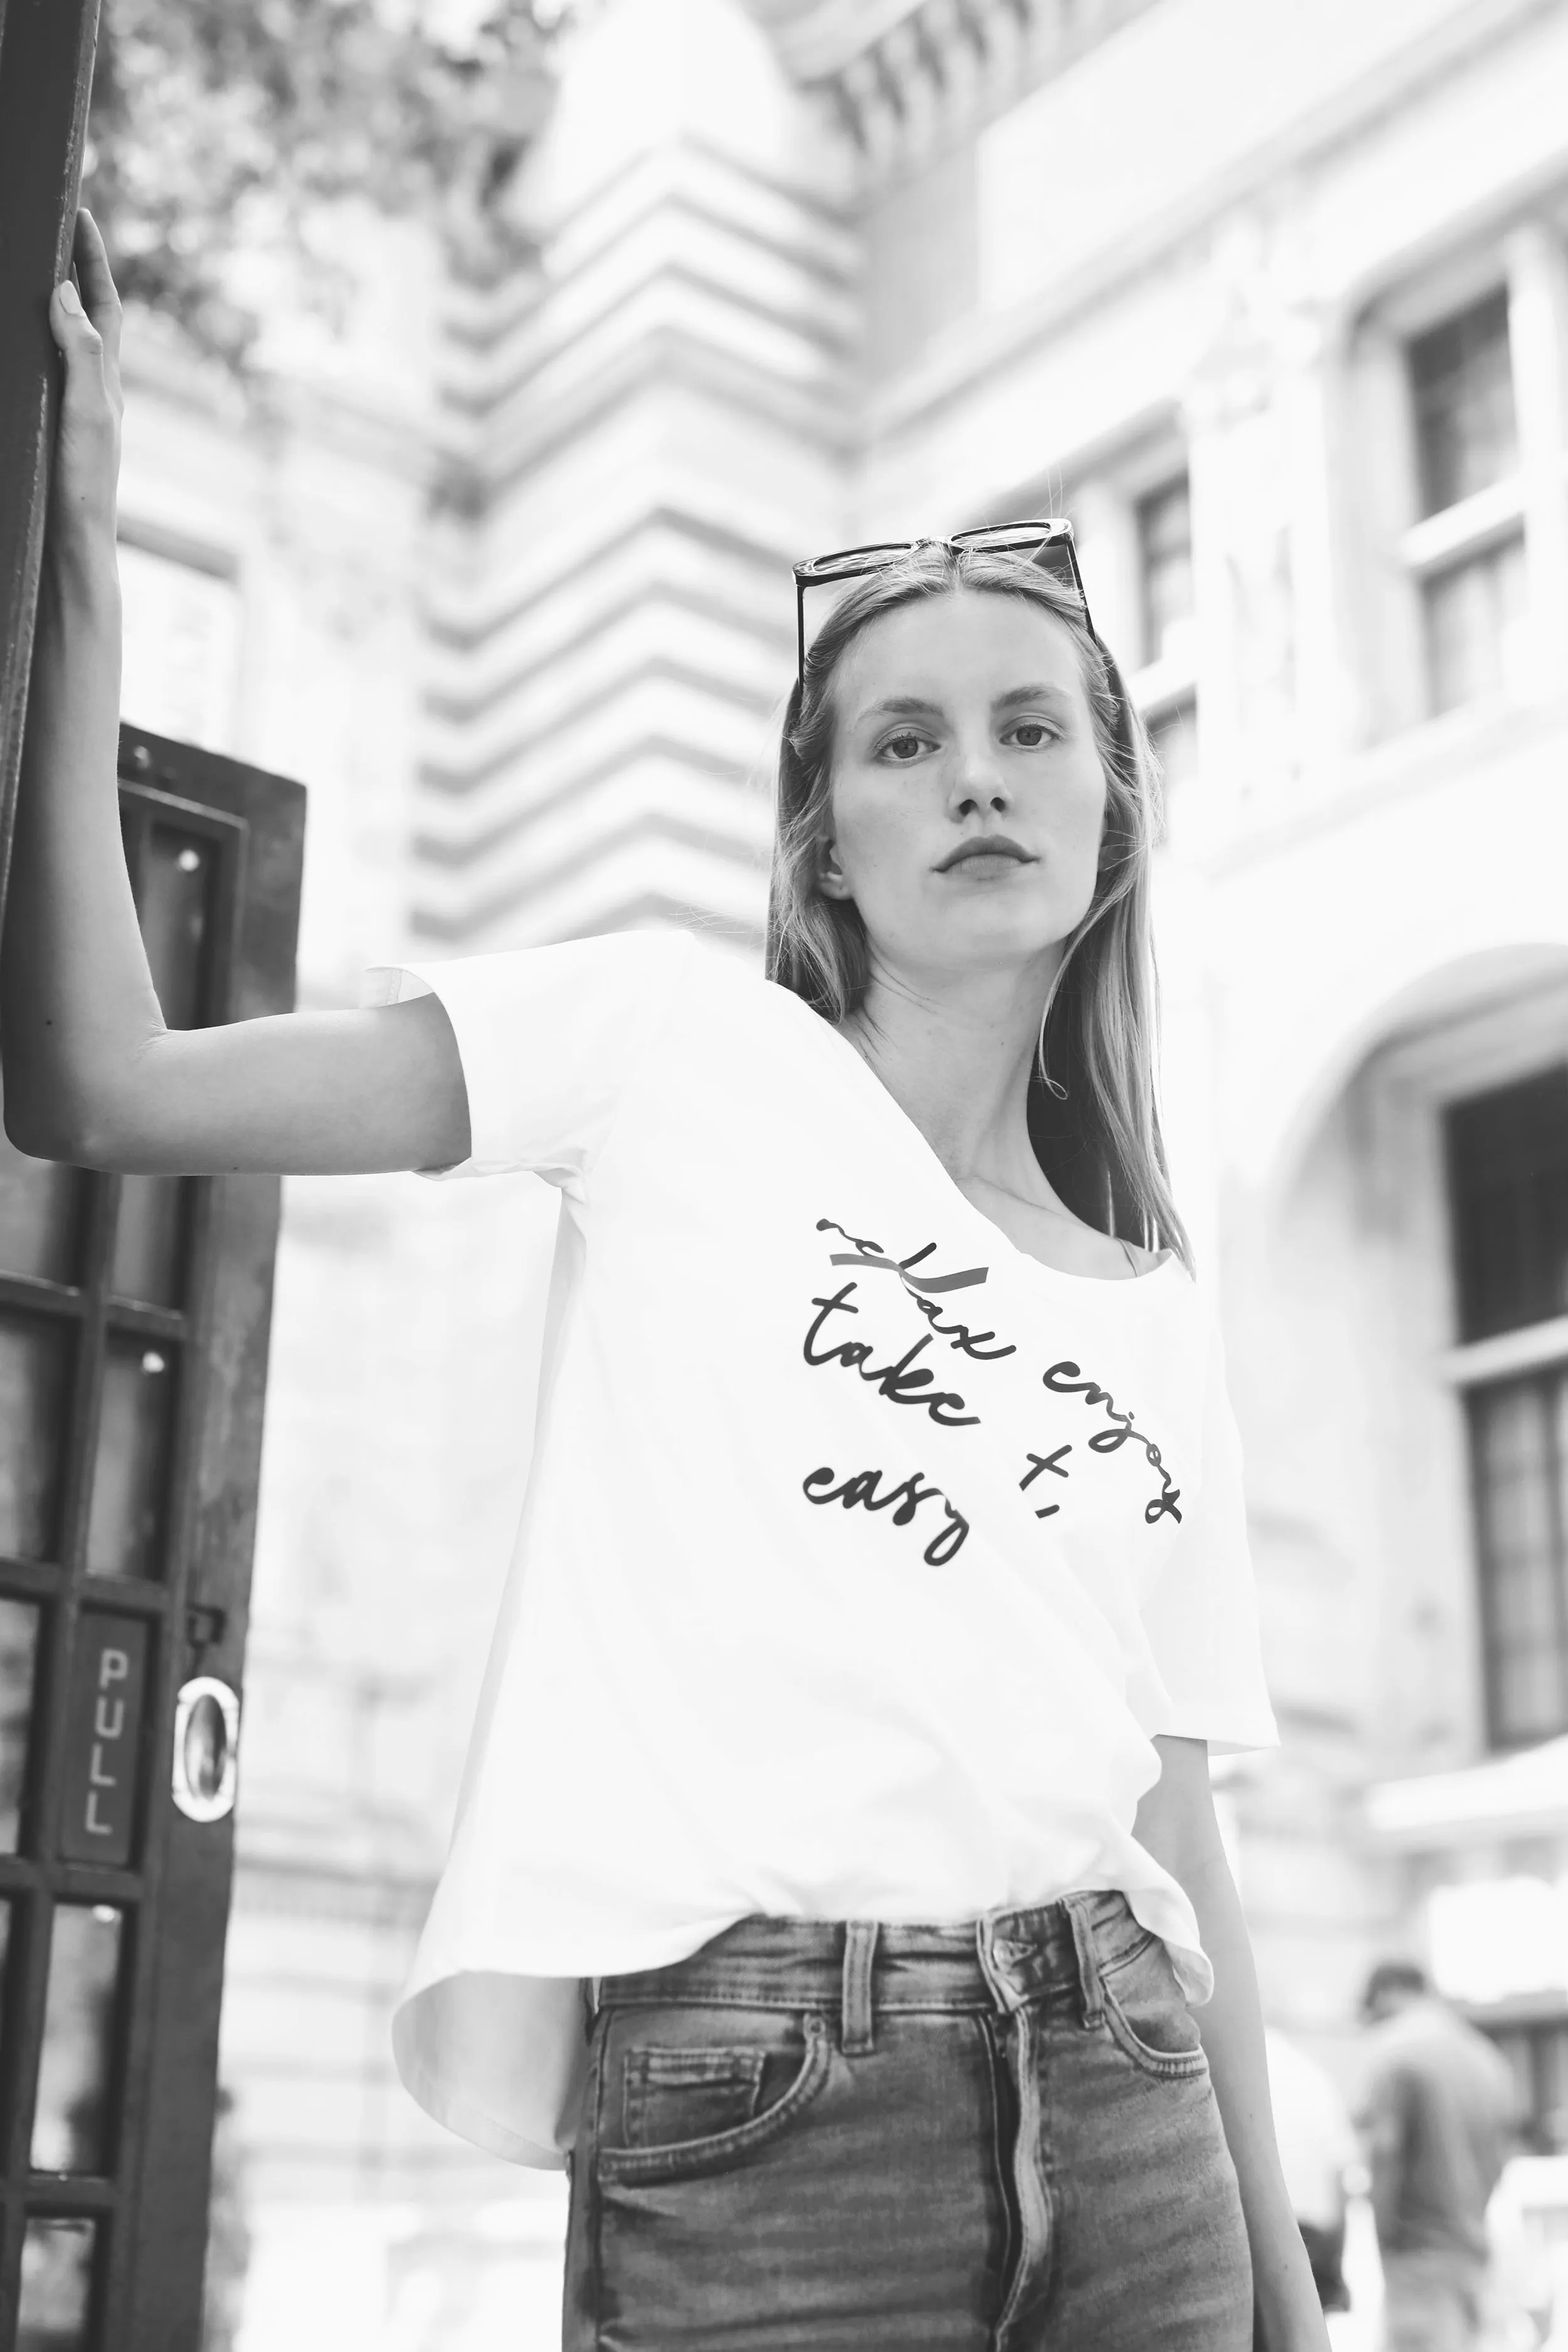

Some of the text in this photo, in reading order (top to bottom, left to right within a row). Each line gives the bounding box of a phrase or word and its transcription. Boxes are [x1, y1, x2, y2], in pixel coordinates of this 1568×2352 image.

[803, 1281, 982, 1427] take
[802, 1466, 970, 1567] easy
[1042, 1361, 1182, 1524] enjoy
[85, 1648, 129, 1836] PULL
